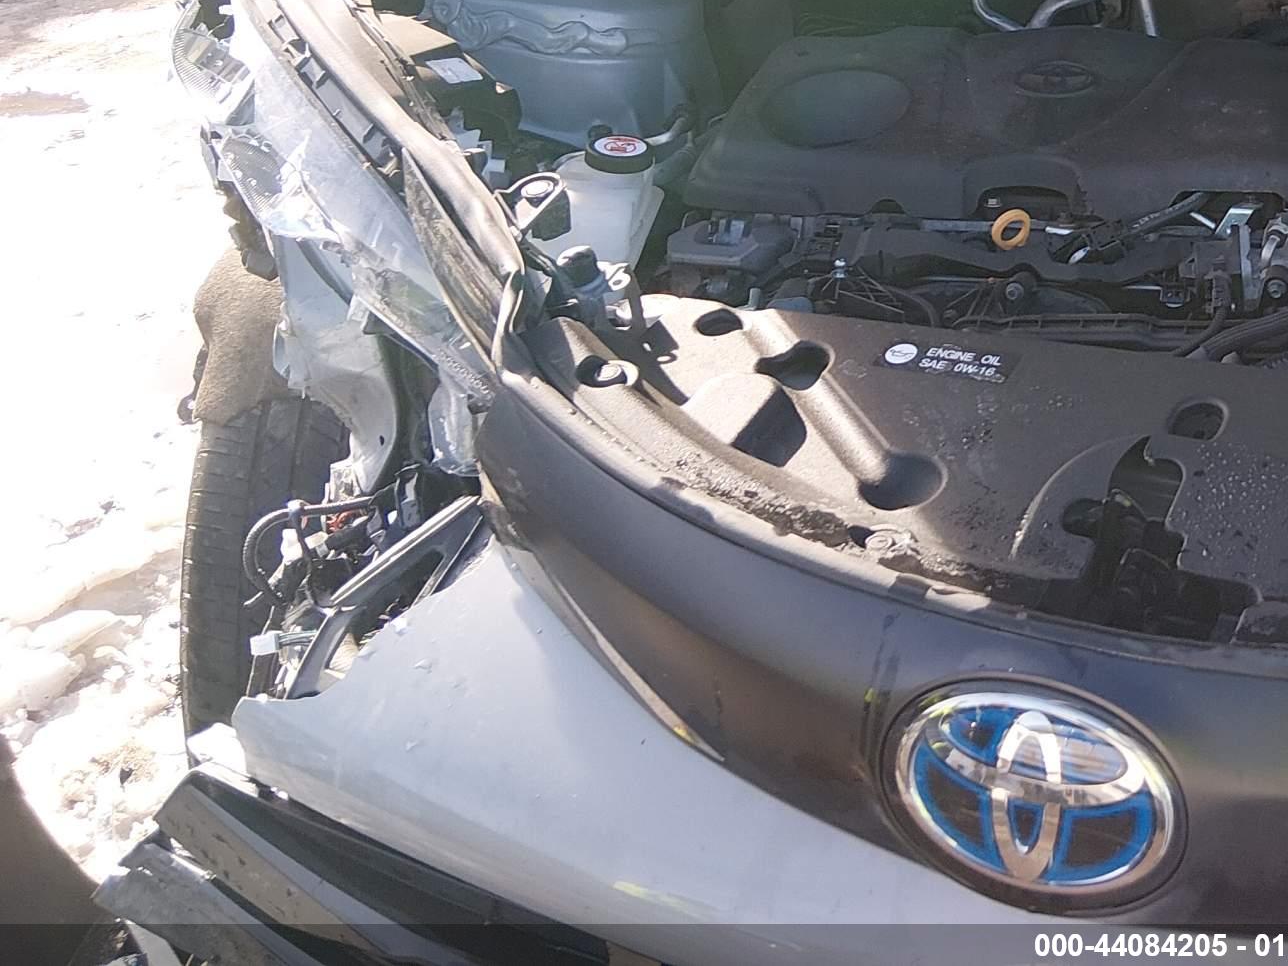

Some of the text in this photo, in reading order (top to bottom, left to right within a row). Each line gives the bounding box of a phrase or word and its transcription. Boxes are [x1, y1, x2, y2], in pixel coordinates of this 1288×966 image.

[919, 358, 947, 370] SAE
[926, 347, 1002, 366] ENGINE OIL
